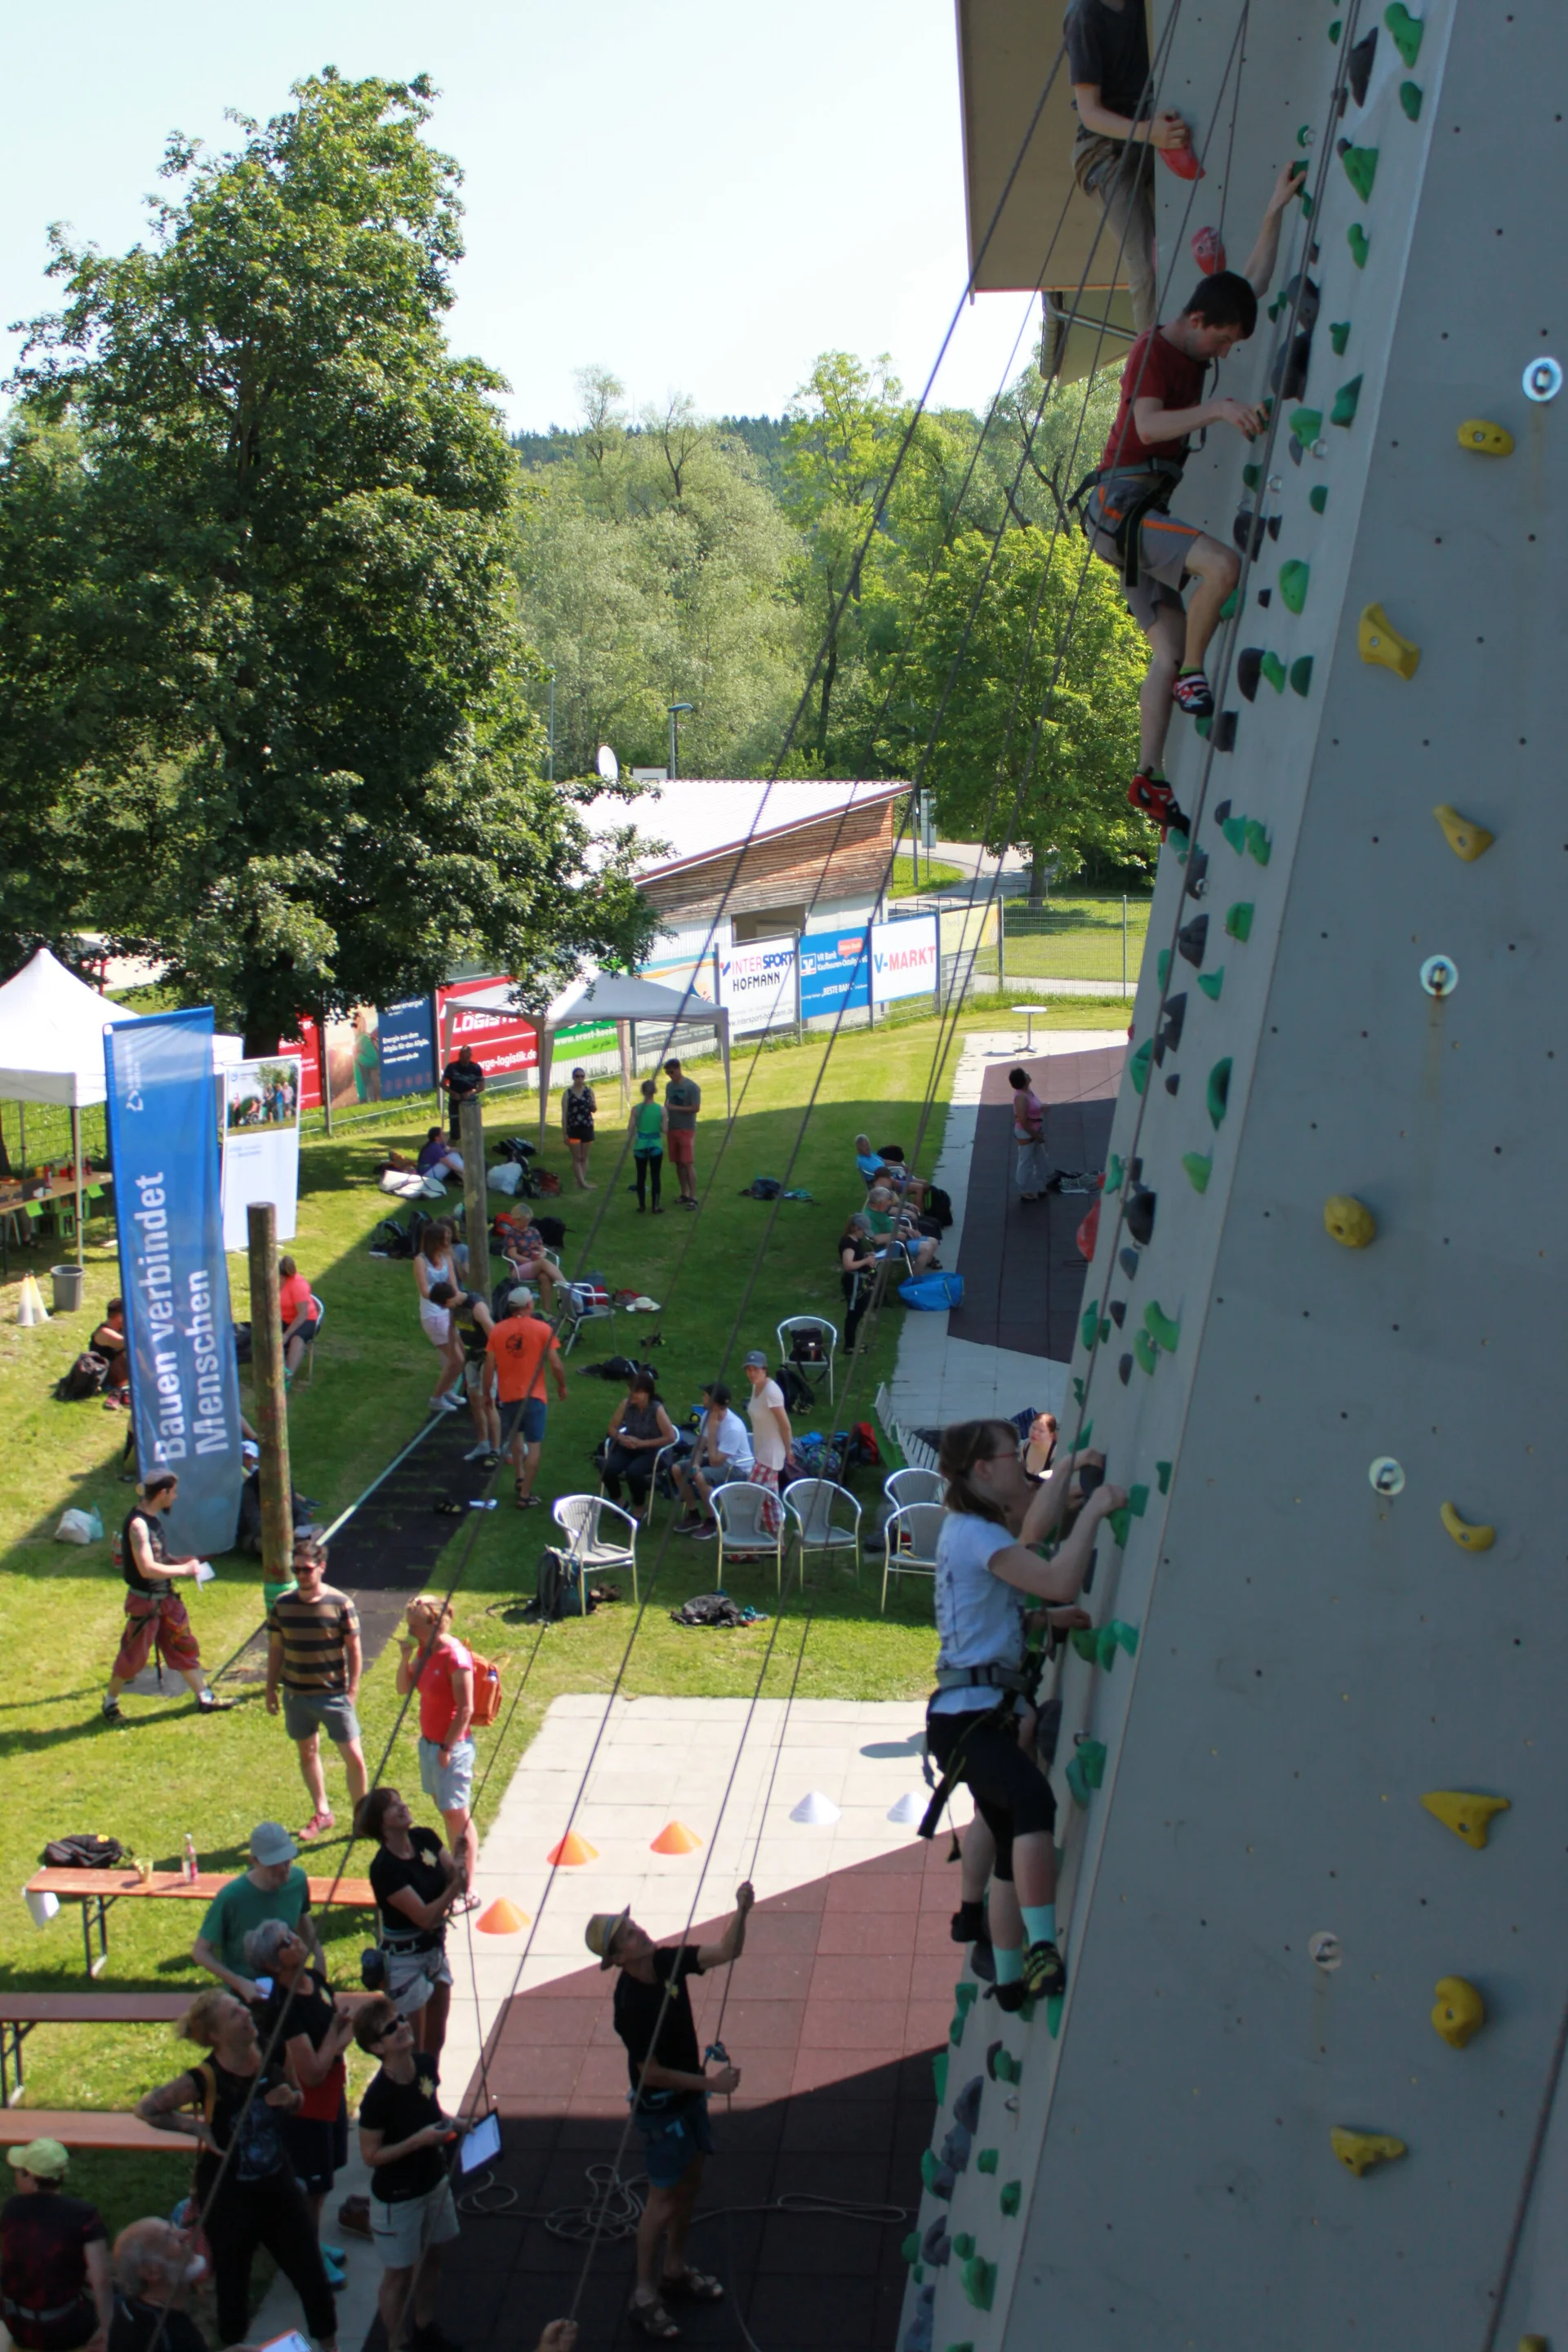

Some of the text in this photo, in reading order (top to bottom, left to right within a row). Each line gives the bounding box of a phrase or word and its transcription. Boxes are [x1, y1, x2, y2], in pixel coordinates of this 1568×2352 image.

[732, 951, 795, 975] INTERSPORT
[817, 951, 838, 962] VR Bank
[873, 945, 937, 974] V-MARKT
[733, 971, 781, 992] HOFMANN
[382, 1035, 400, 1044] Energie
[133, 1170, 188, 1463] Bauen verbindet
[184, 1269, 229, 1455] Menschen
